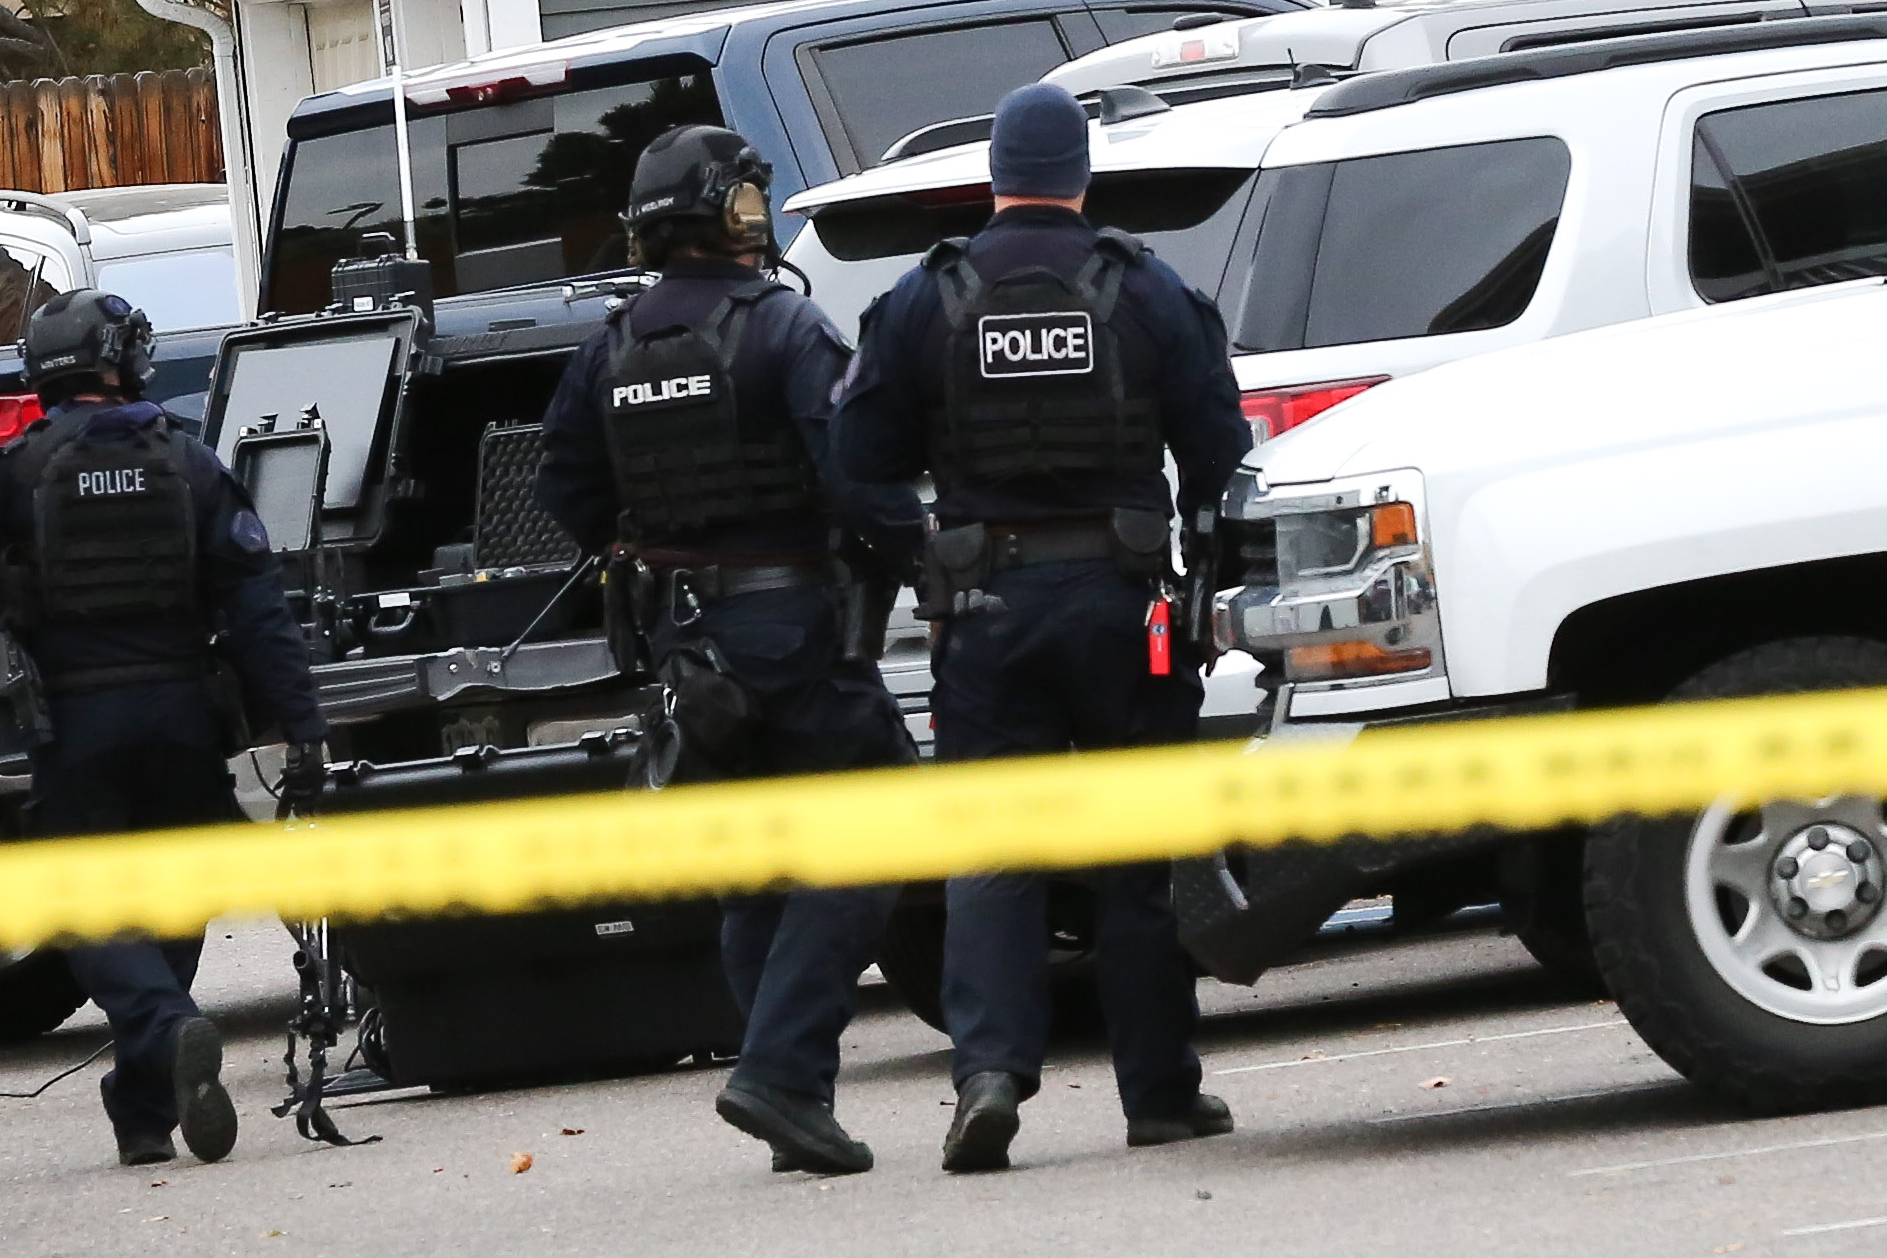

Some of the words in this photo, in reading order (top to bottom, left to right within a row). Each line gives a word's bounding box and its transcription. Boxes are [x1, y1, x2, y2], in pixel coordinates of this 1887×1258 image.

[985, 327, 1087, 364] POLICE
[613, 374, 711, 408] POLICE
[78, 468, 146, 496] POLICE
